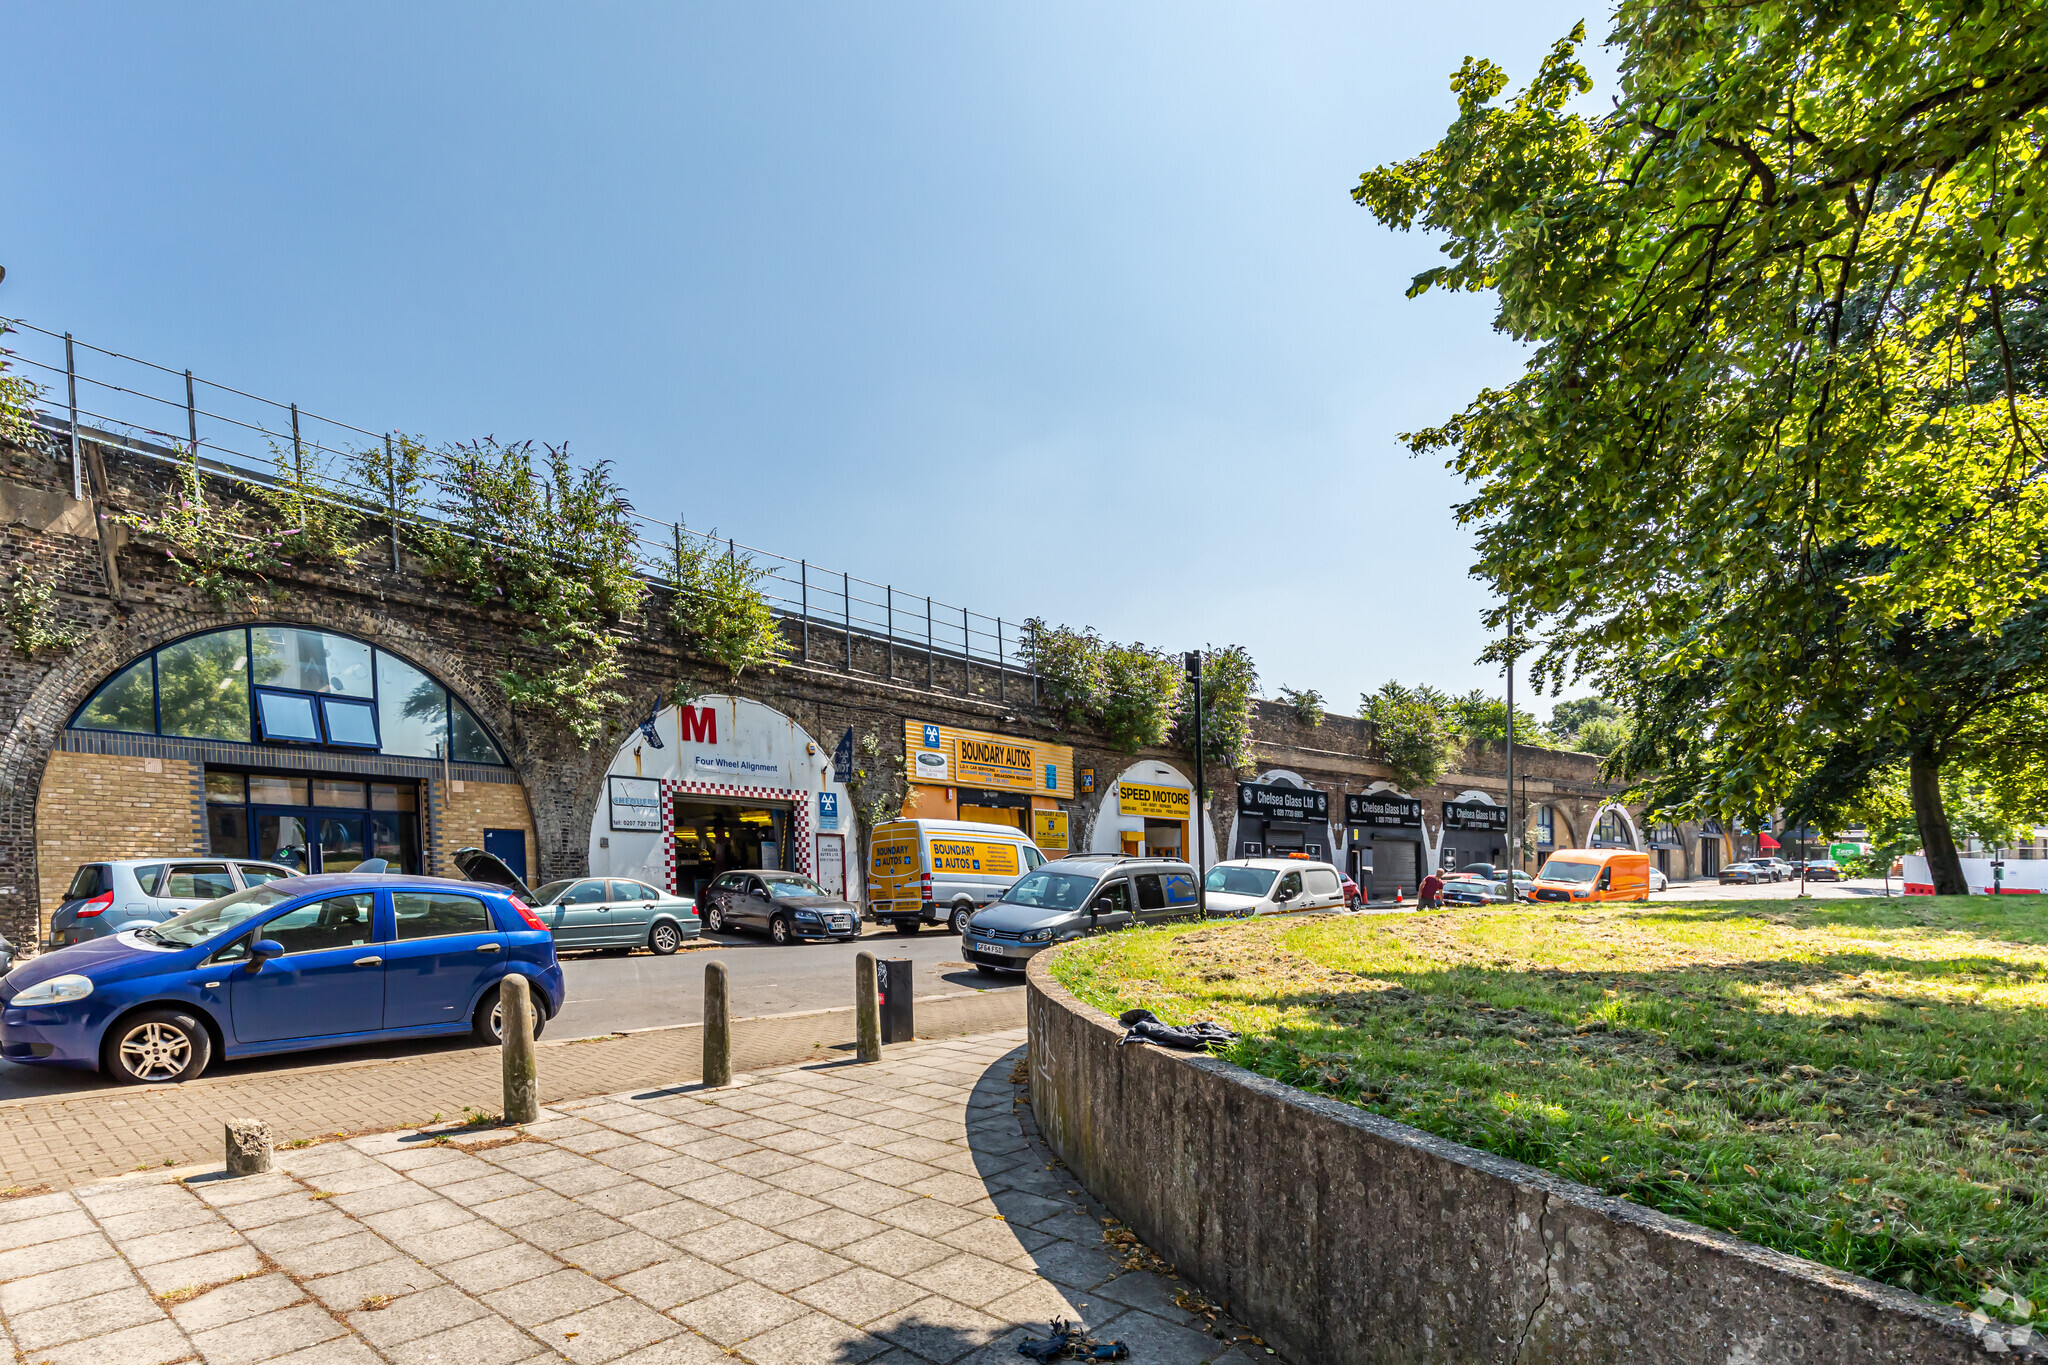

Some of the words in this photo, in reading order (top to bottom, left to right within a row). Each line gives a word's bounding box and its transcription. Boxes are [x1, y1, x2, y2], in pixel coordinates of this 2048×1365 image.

[681, 704, 717, 745] M
[961, 741, 1005, 765] BOUNDARY
[1005, 748, 1031, 769] AUTOS
[695, 756, 714, 766] Four
[715, 758, 740, 769] Wheel
[740, 761, 778, 773] Alignment
[1120, 786, 1151, 801] SPEED
[1152, 790, 1189, 805] MOTORS
[1257, 791, 1284, 806] Chelsea
[1284, 794, 1303, 808] Glass
[1303, 796, 1314, 808] Ltd
[1362, 801, 1384, 814] Chelsea
[1384, 803, 1399, 815] Glass
[1400, 804, 1409, 815] Ltd
[1456, 808, 1475, 819] Chelsea
[1475, 809, 1488, 820] Glass
[1489, 810, 1497, 820] Ltd
[877, 845, 909, 856] BOUNDARY
[934, 844, 975, 856] BOUNDARY
[882, 856, 902, 866] AUTOS
[945, 858, 970, 869] AUTOS
